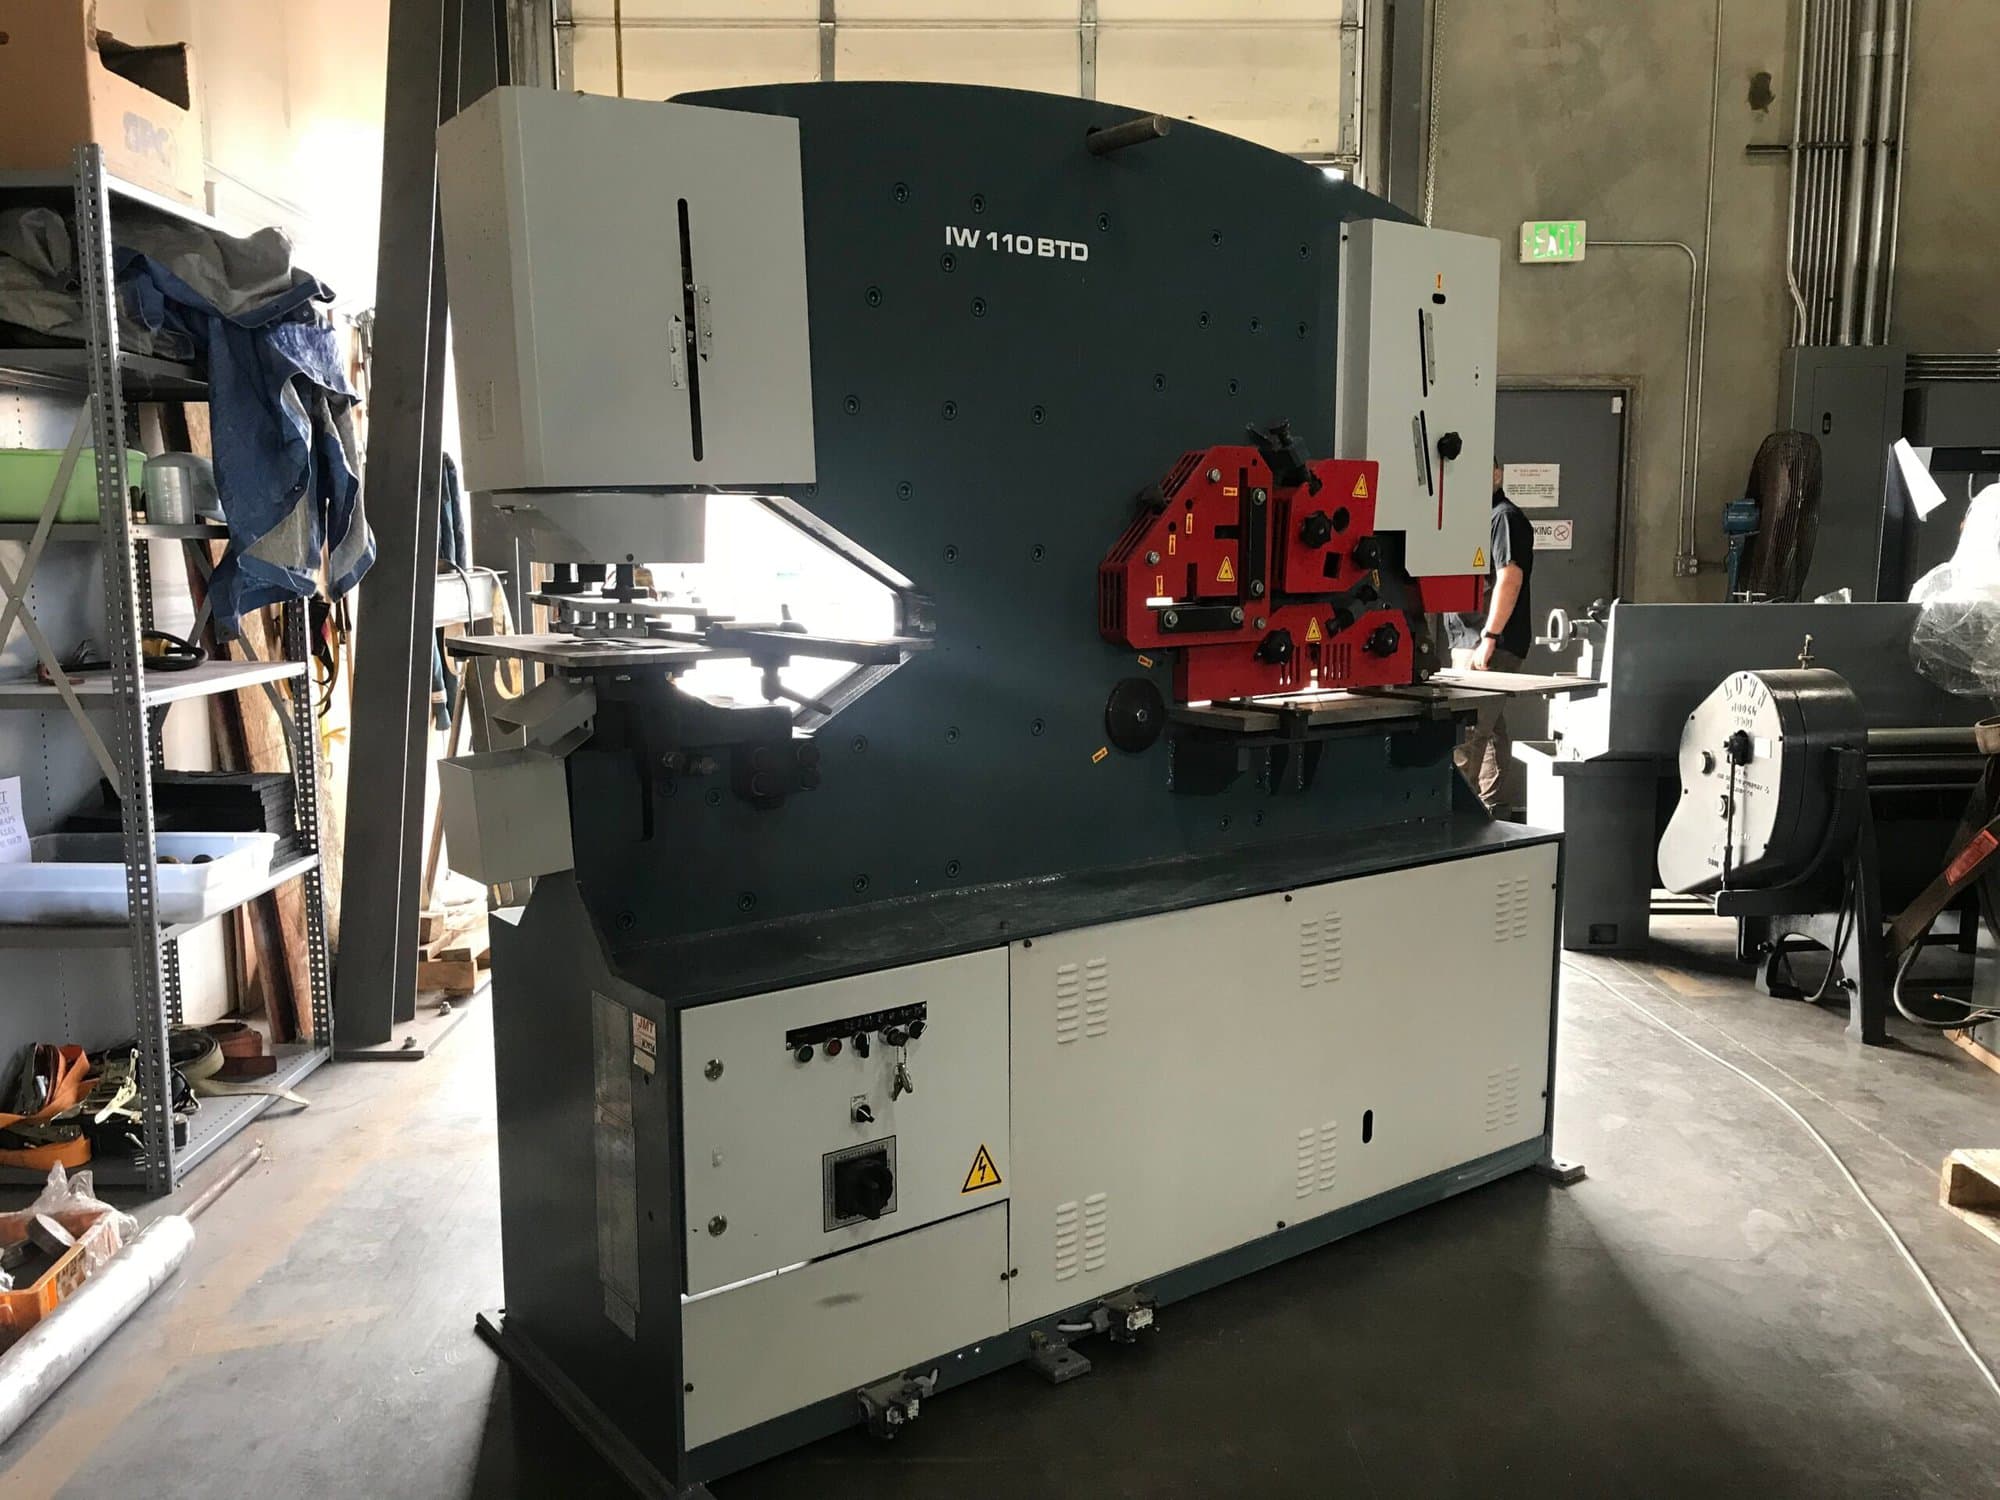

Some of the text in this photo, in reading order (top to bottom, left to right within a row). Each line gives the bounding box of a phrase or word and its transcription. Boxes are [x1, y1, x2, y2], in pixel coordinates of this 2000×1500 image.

[945, 226, 1089, 262] IW 110 BTD
[1533, 223, 1577, 258] EXIT
[1534, 526, 1553, 536] KING
